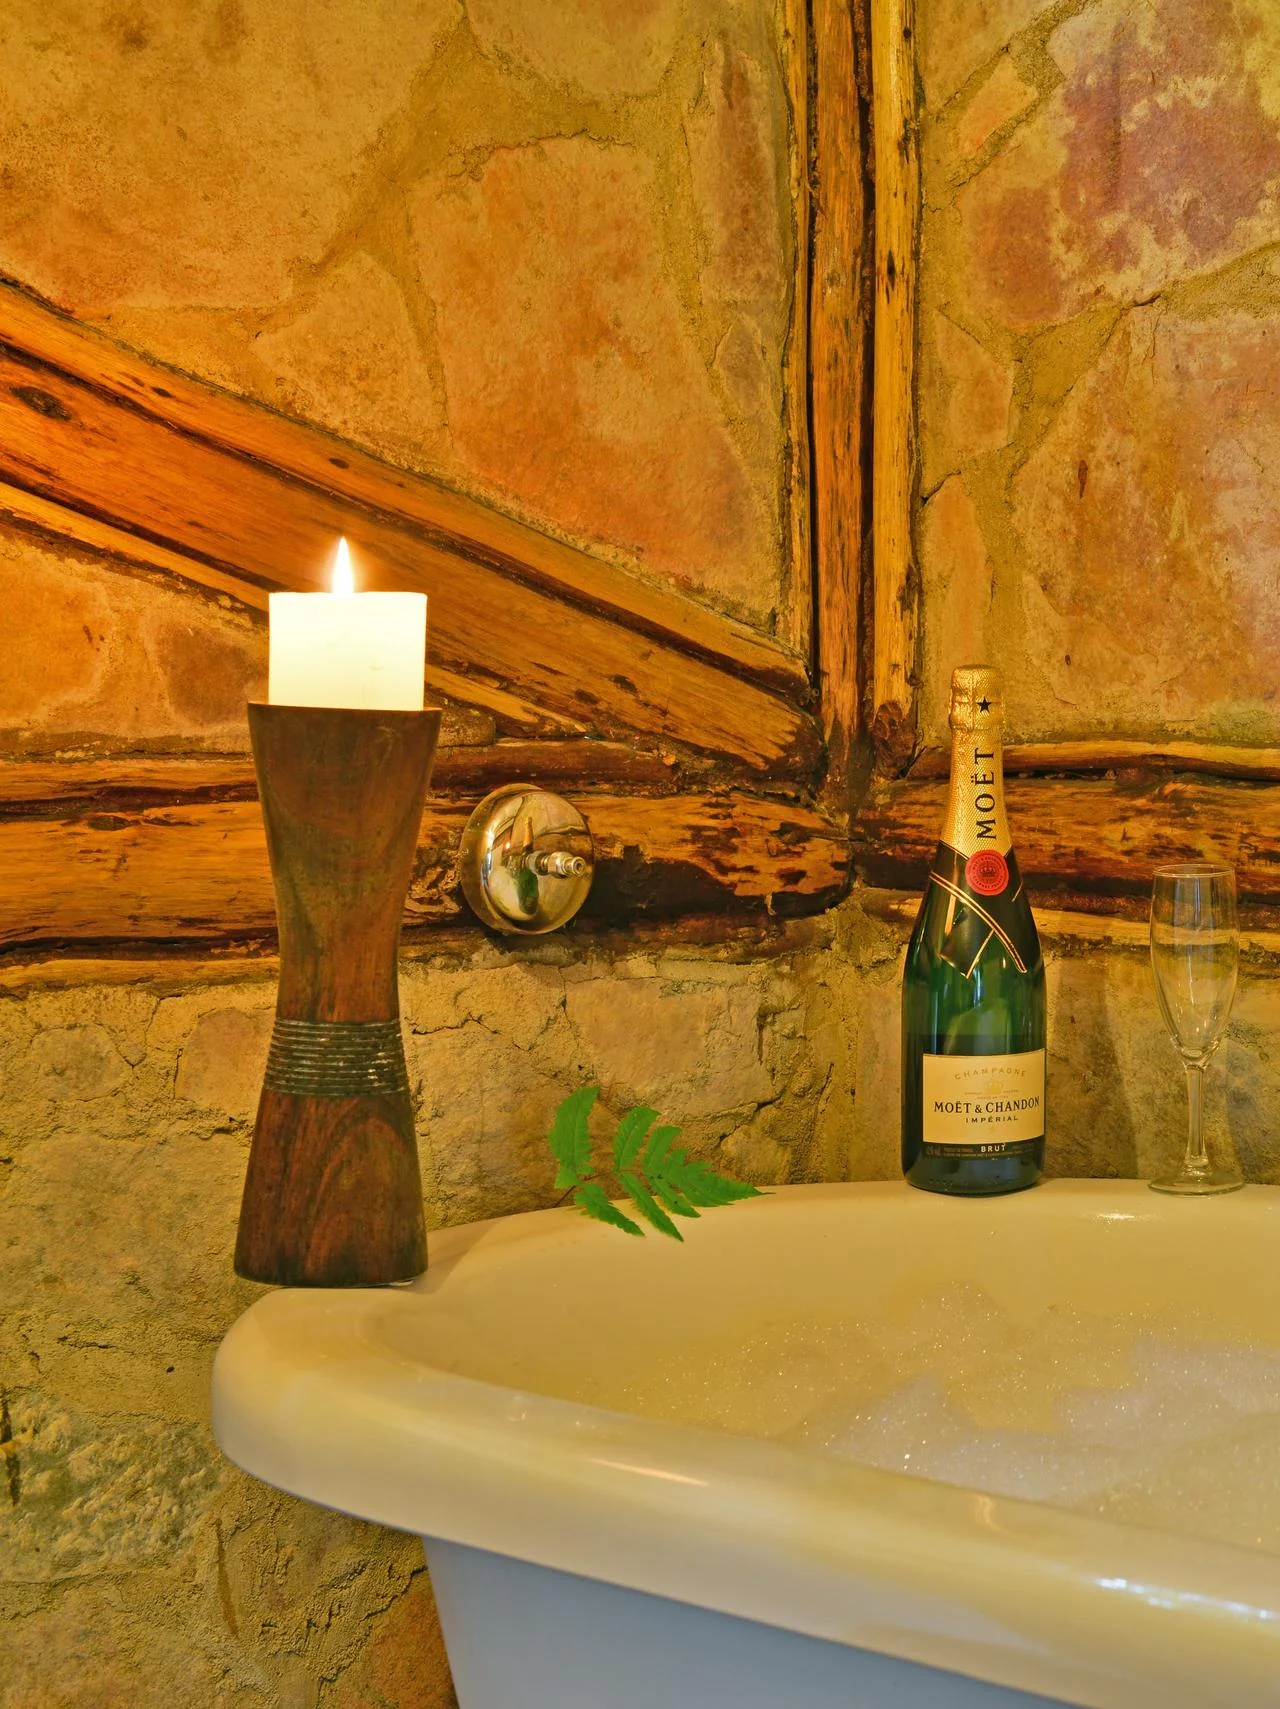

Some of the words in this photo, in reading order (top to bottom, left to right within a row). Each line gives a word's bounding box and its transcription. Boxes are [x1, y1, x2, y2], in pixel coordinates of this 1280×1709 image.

[971, 747, 997, 839] MOËT
[954, 1067, 1027, 1080] CHAMPAGNE
[934, 1101, 972, 1113] MOËT
[974, 1104, 984, 1113] &
[985, 1095, 1040, 1113] CHANDON
[965, 1115, 1019, 1124] IMPÉRIAL
[980, 1144, 1006, 1153] BRUT
